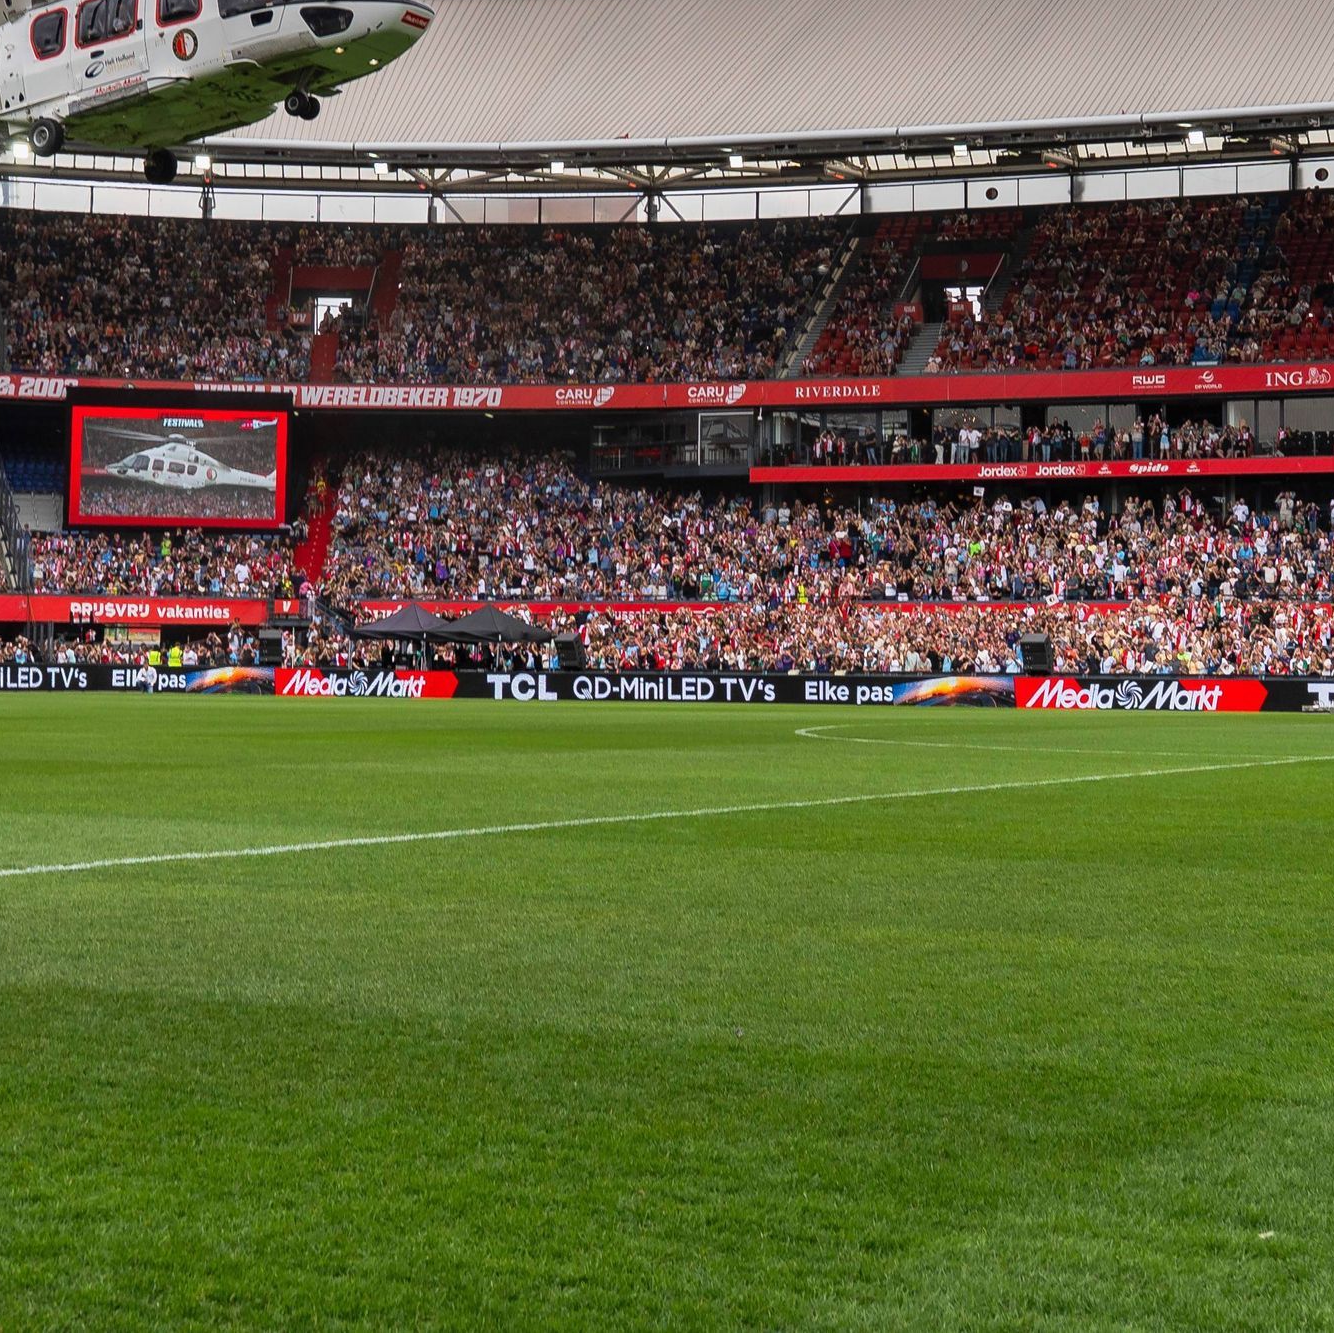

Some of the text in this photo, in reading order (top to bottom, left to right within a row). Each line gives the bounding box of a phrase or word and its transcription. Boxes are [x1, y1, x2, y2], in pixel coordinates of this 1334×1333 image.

[1266, 371, 1303, 386] ING
[300, 386, 450, 407] WERELDBEKER
[452, 386, 502, 407] 1970
[555, 388, 593, 400] CARU
[687, 385, 725, 398] CARU
[794, 384, 881, 398] RIVERDALE
[978, 465, 1017, 478] Jordex
[1035, 464, 1075, 477] Jordex
[1128, 462, 1169, 475] Spido
[156, 602, 230, 619] vakanties
[158, 672, 186, 690] pas
[283, 669, 426, 697] Media Markt
[487, 673, 557, 701] TCL
[805, 680, 893, 705] Elke pas
[1025, 679, 1223, 711] Media Markt
